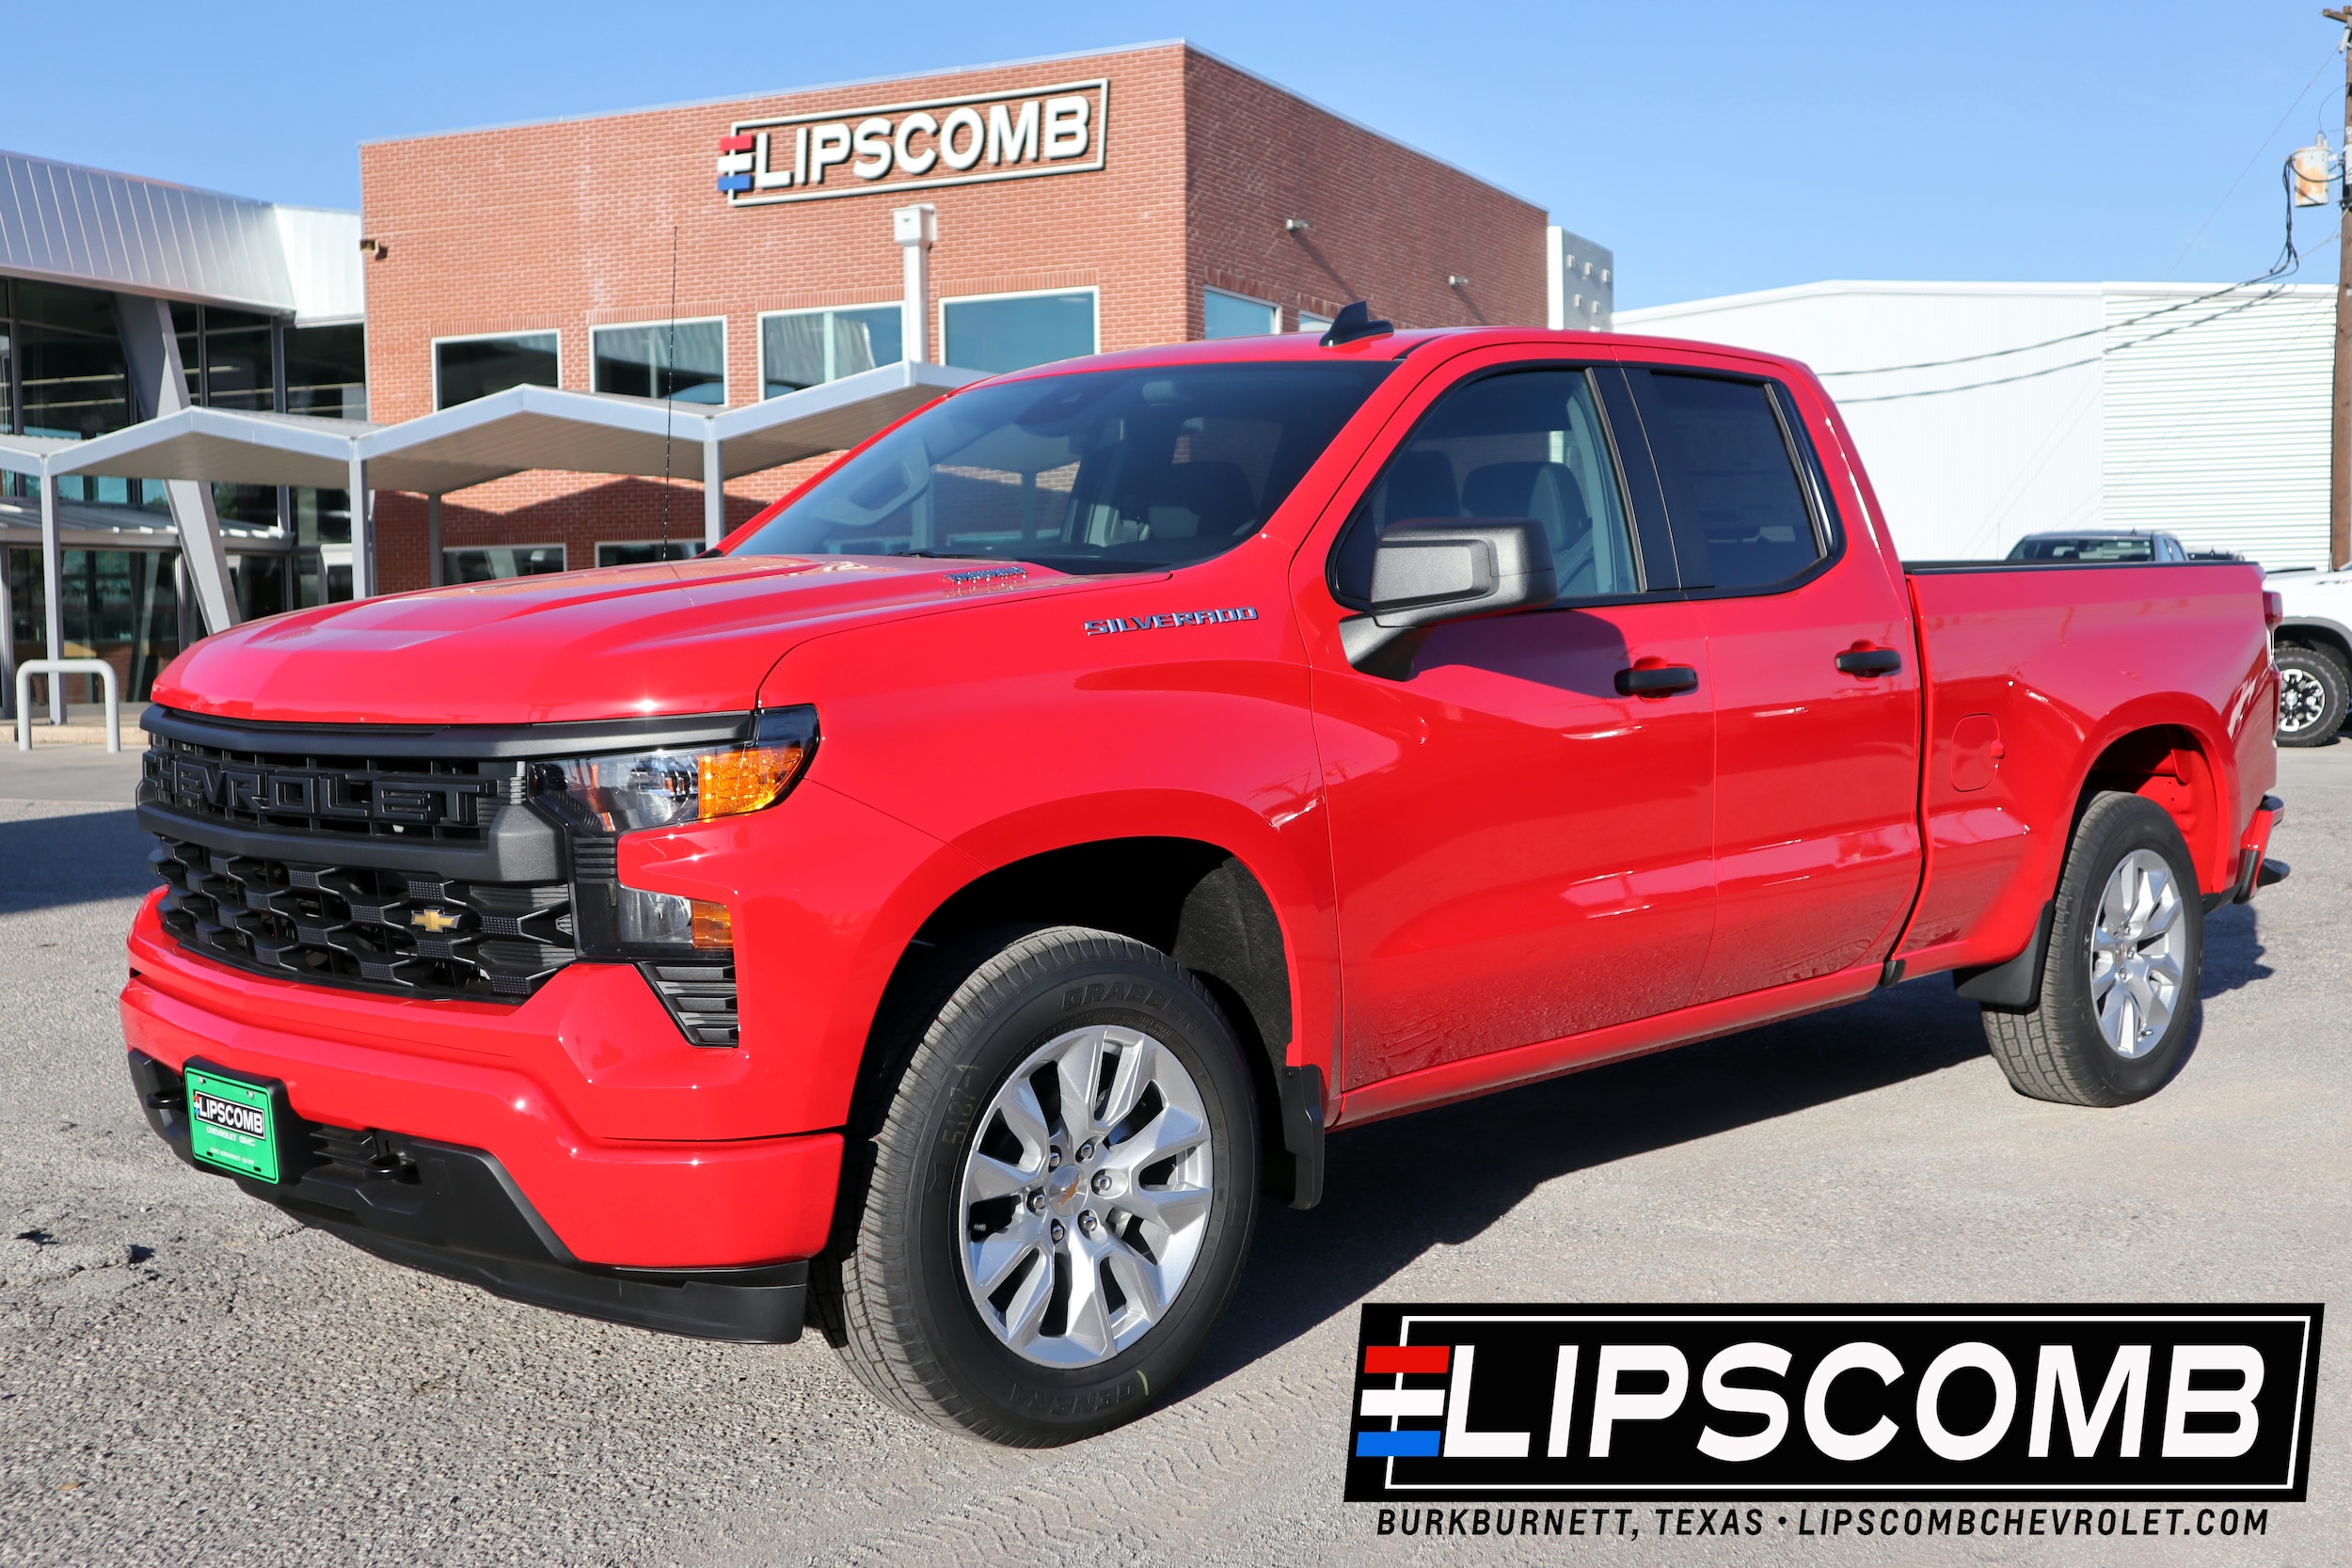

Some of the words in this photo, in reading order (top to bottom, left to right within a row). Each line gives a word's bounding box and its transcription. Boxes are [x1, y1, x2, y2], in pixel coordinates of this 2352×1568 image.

[754, 94, 1091, 189] LIPSCOMB
[1084, 606, 1259, 637] SILVERADO
[142, 752, 485, 824] CHEVROLET
[1060, 981, 1203, 1035] GRABBER
[198, 1096, 263, 1134] LIPSCOMB
